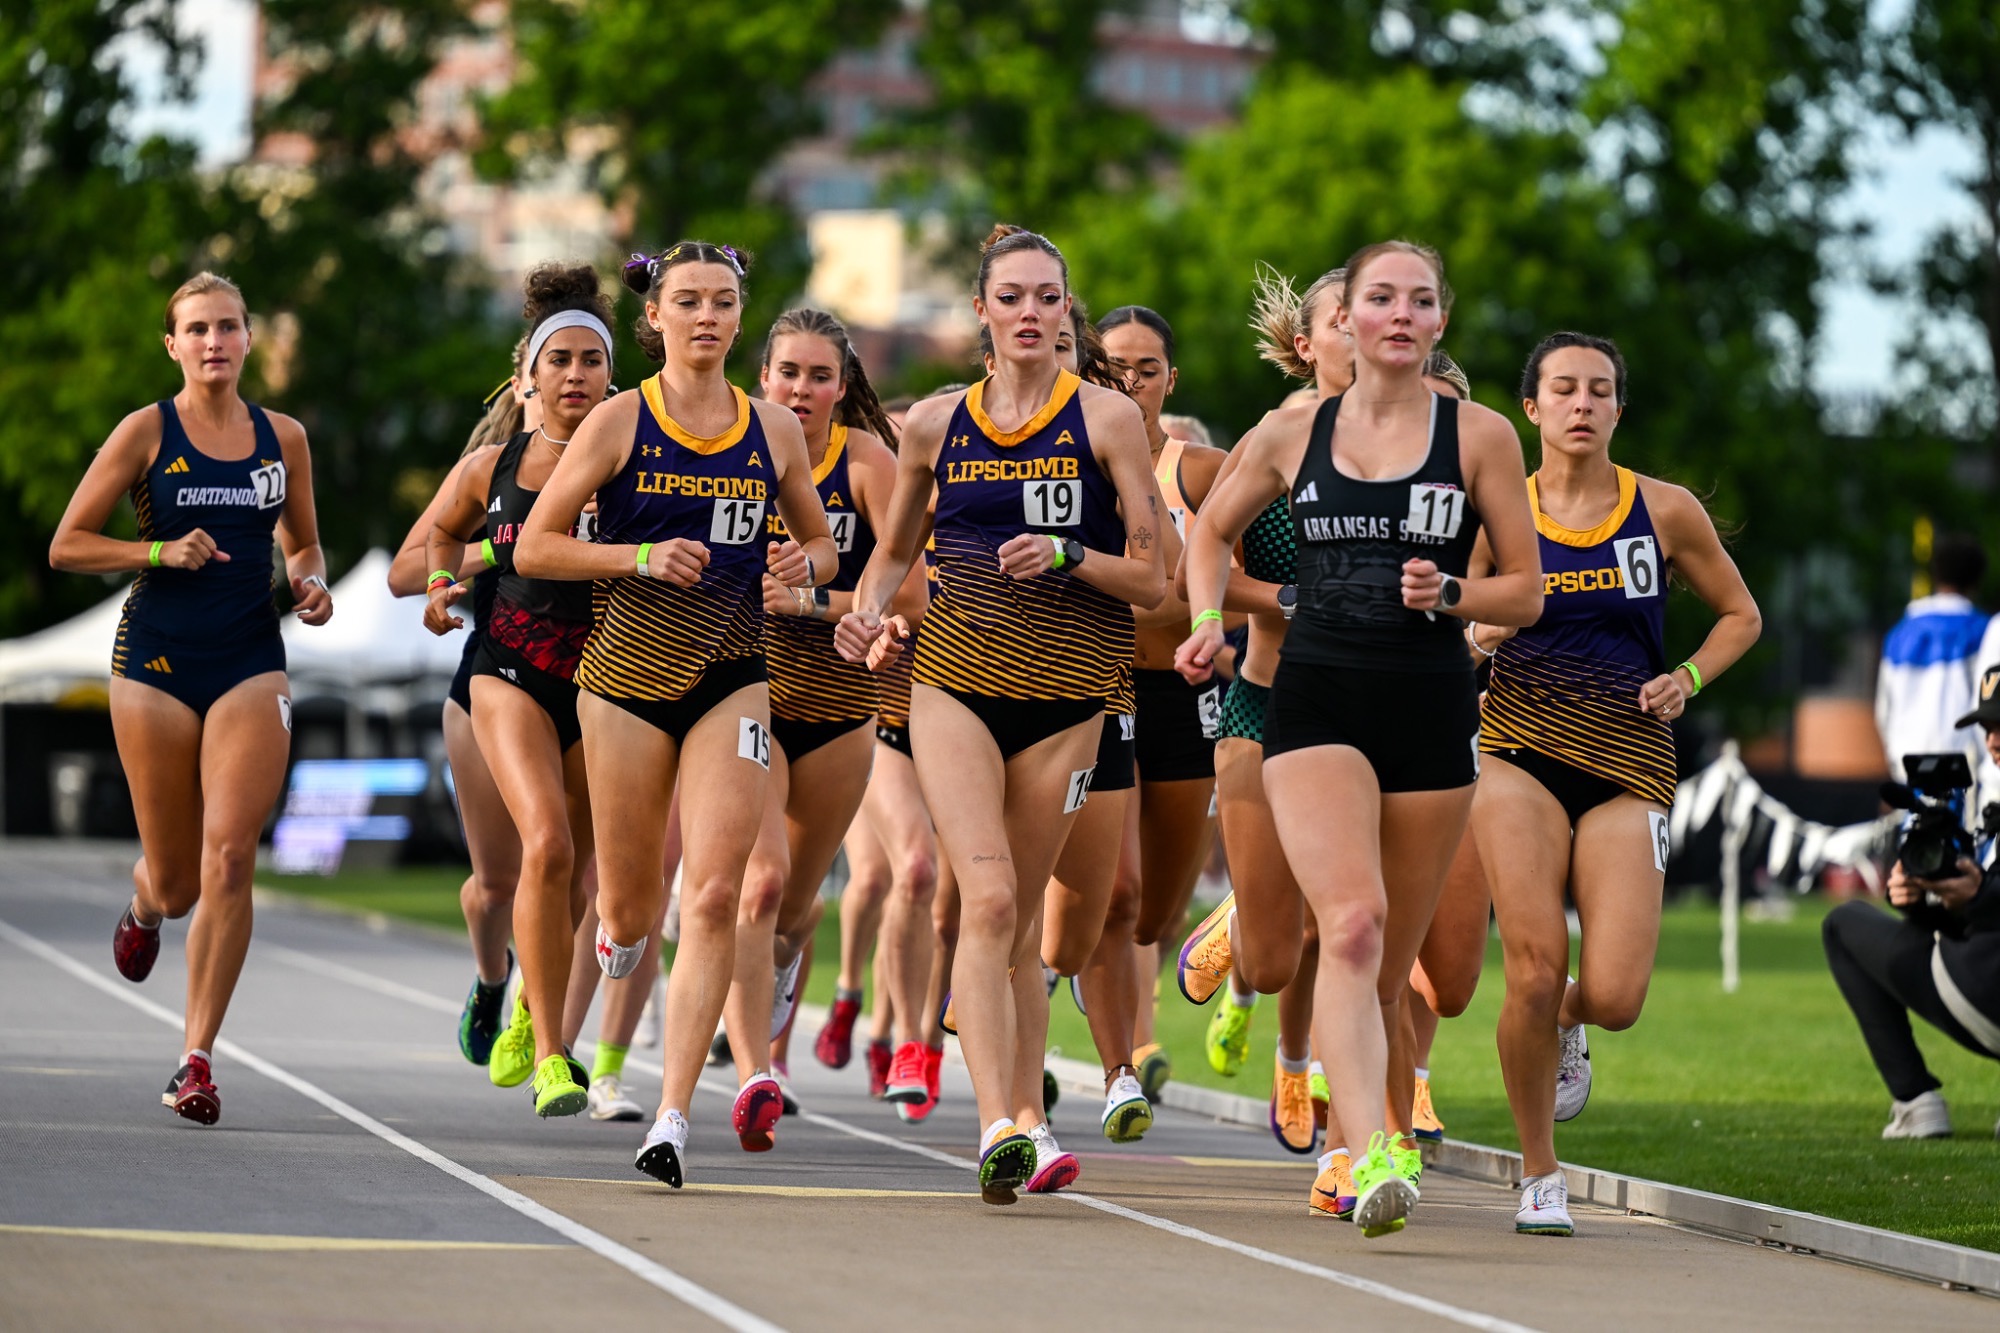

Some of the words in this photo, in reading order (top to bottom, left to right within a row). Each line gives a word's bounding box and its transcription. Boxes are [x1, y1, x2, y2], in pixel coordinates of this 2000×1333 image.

[258, 466, 283, 506] 22
[636, 471, 767, 500] LIPSCOMB
[947, 457, 1079, 483] LIPSCOMB
[723, 501, 758, 541] 15
[1033, 482, 1073, 523] 19
[1421, 489, 1454, 534] 11
[1304, 516, 1389, 541] ARKANSAS
[1627, 540, 1652, 594] 6
[749, 723, 769, 767] 15
[1657, 816, 1667, 870] 6
